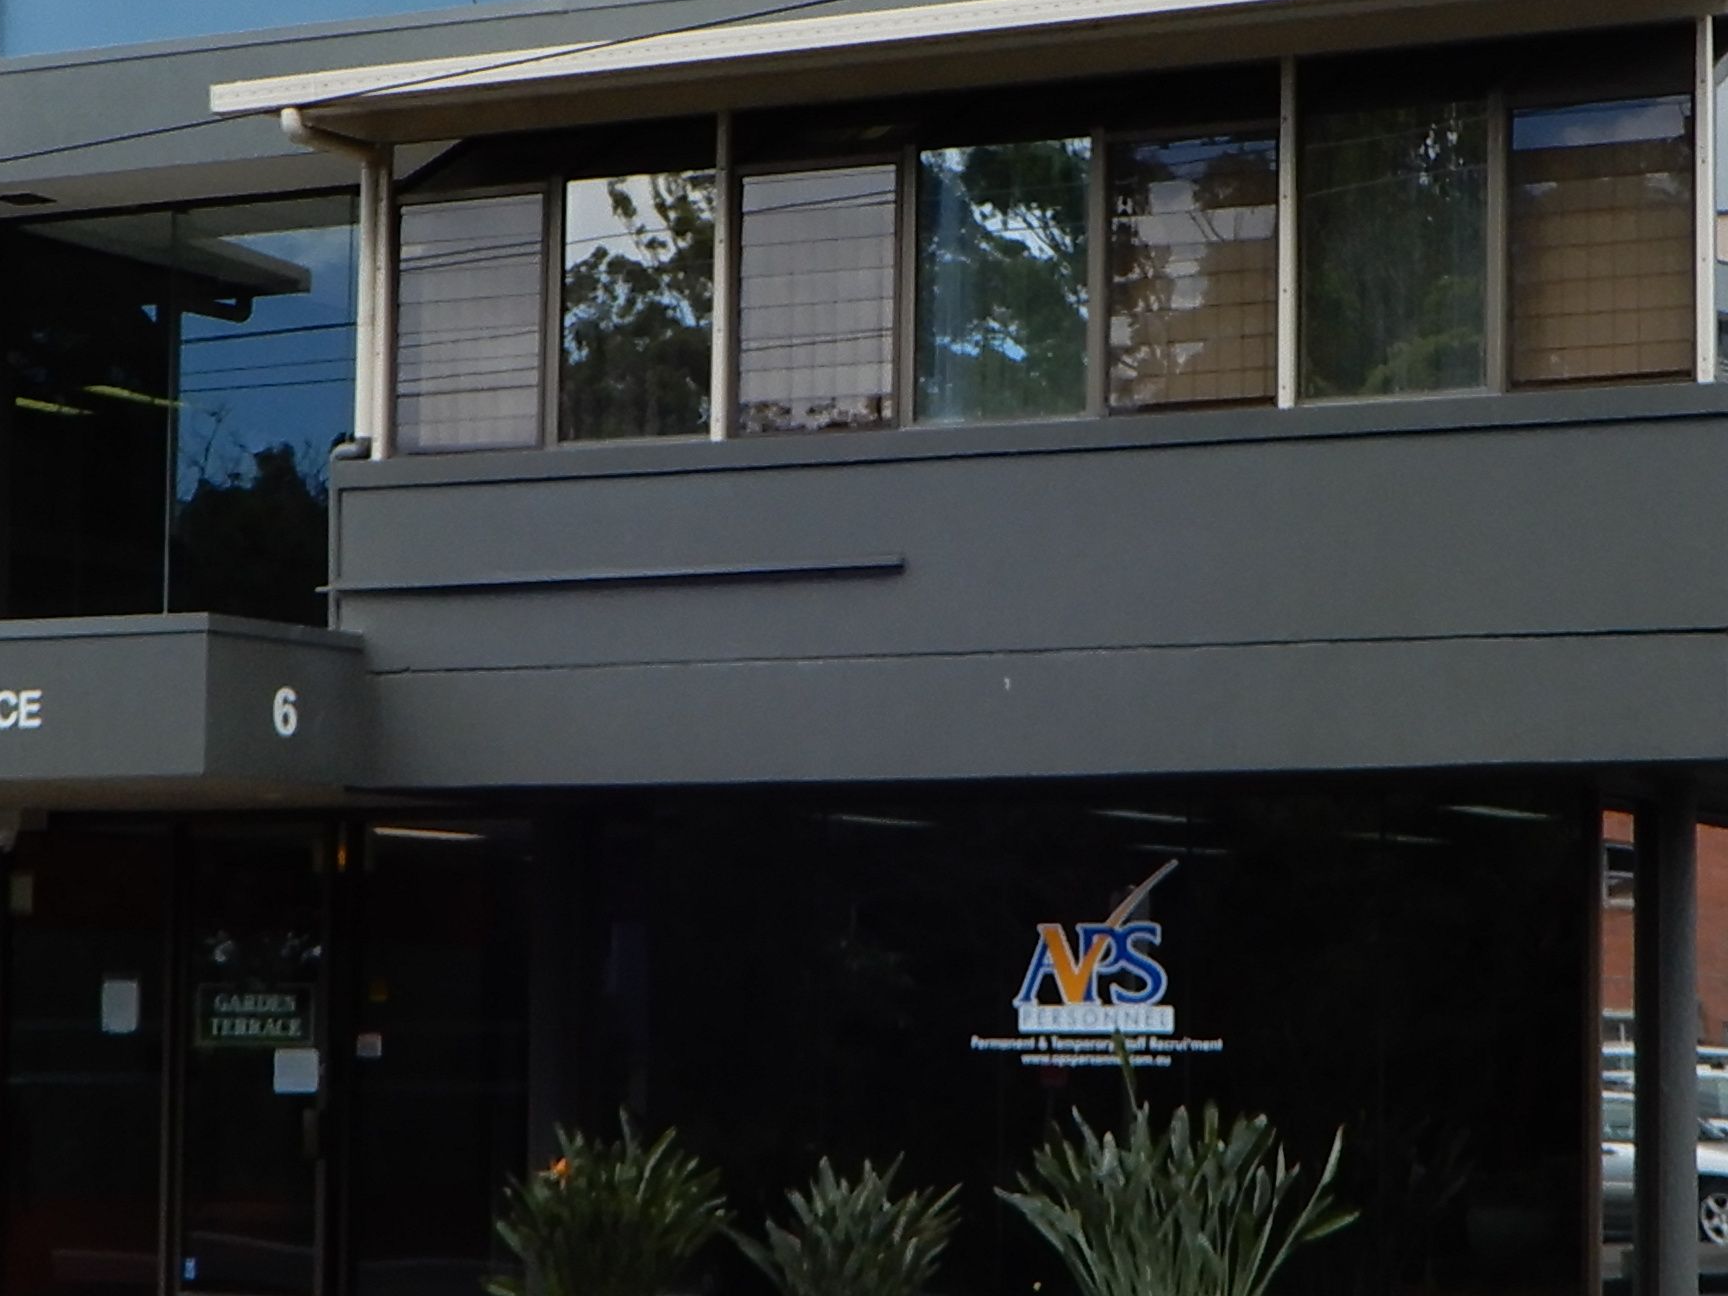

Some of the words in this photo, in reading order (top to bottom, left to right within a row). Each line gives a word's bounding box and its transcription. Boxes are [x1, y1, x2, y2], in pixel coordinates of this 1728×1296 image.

[272, 688, 297, 737] 6
[213, 993, 297, 1012] GARDEN
[210, 1016, 302, 1037] TERRACE
[970, 1034, 1035, 1050] Permanent
[1038, 1035, 1048, 1051] &
[1051, 1035, 1115, 1053] Temporary
[1148, 1035, 1224, 1052] Recruitment
